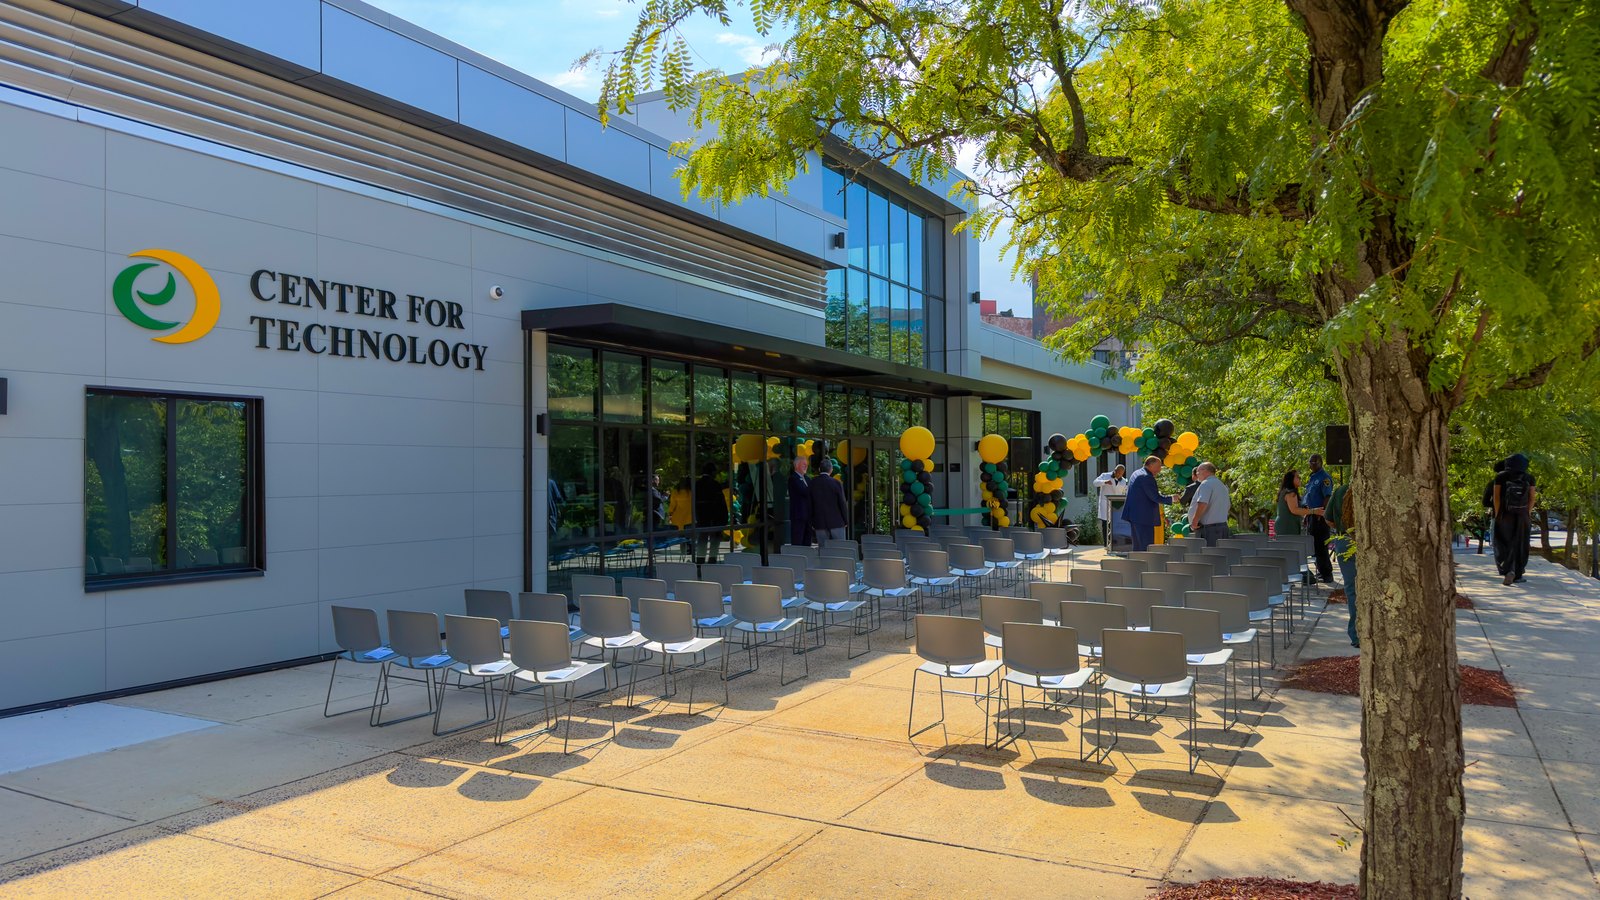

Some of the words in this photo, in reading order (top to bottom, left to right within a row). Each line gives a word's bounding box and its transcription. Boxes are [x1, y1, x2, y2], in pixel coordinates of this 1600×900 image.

[249, 269, 398, 320] CENTER
[407, 294, 465, 329] FOR
[249, 315, 489, 371] TECHNOLOGY
